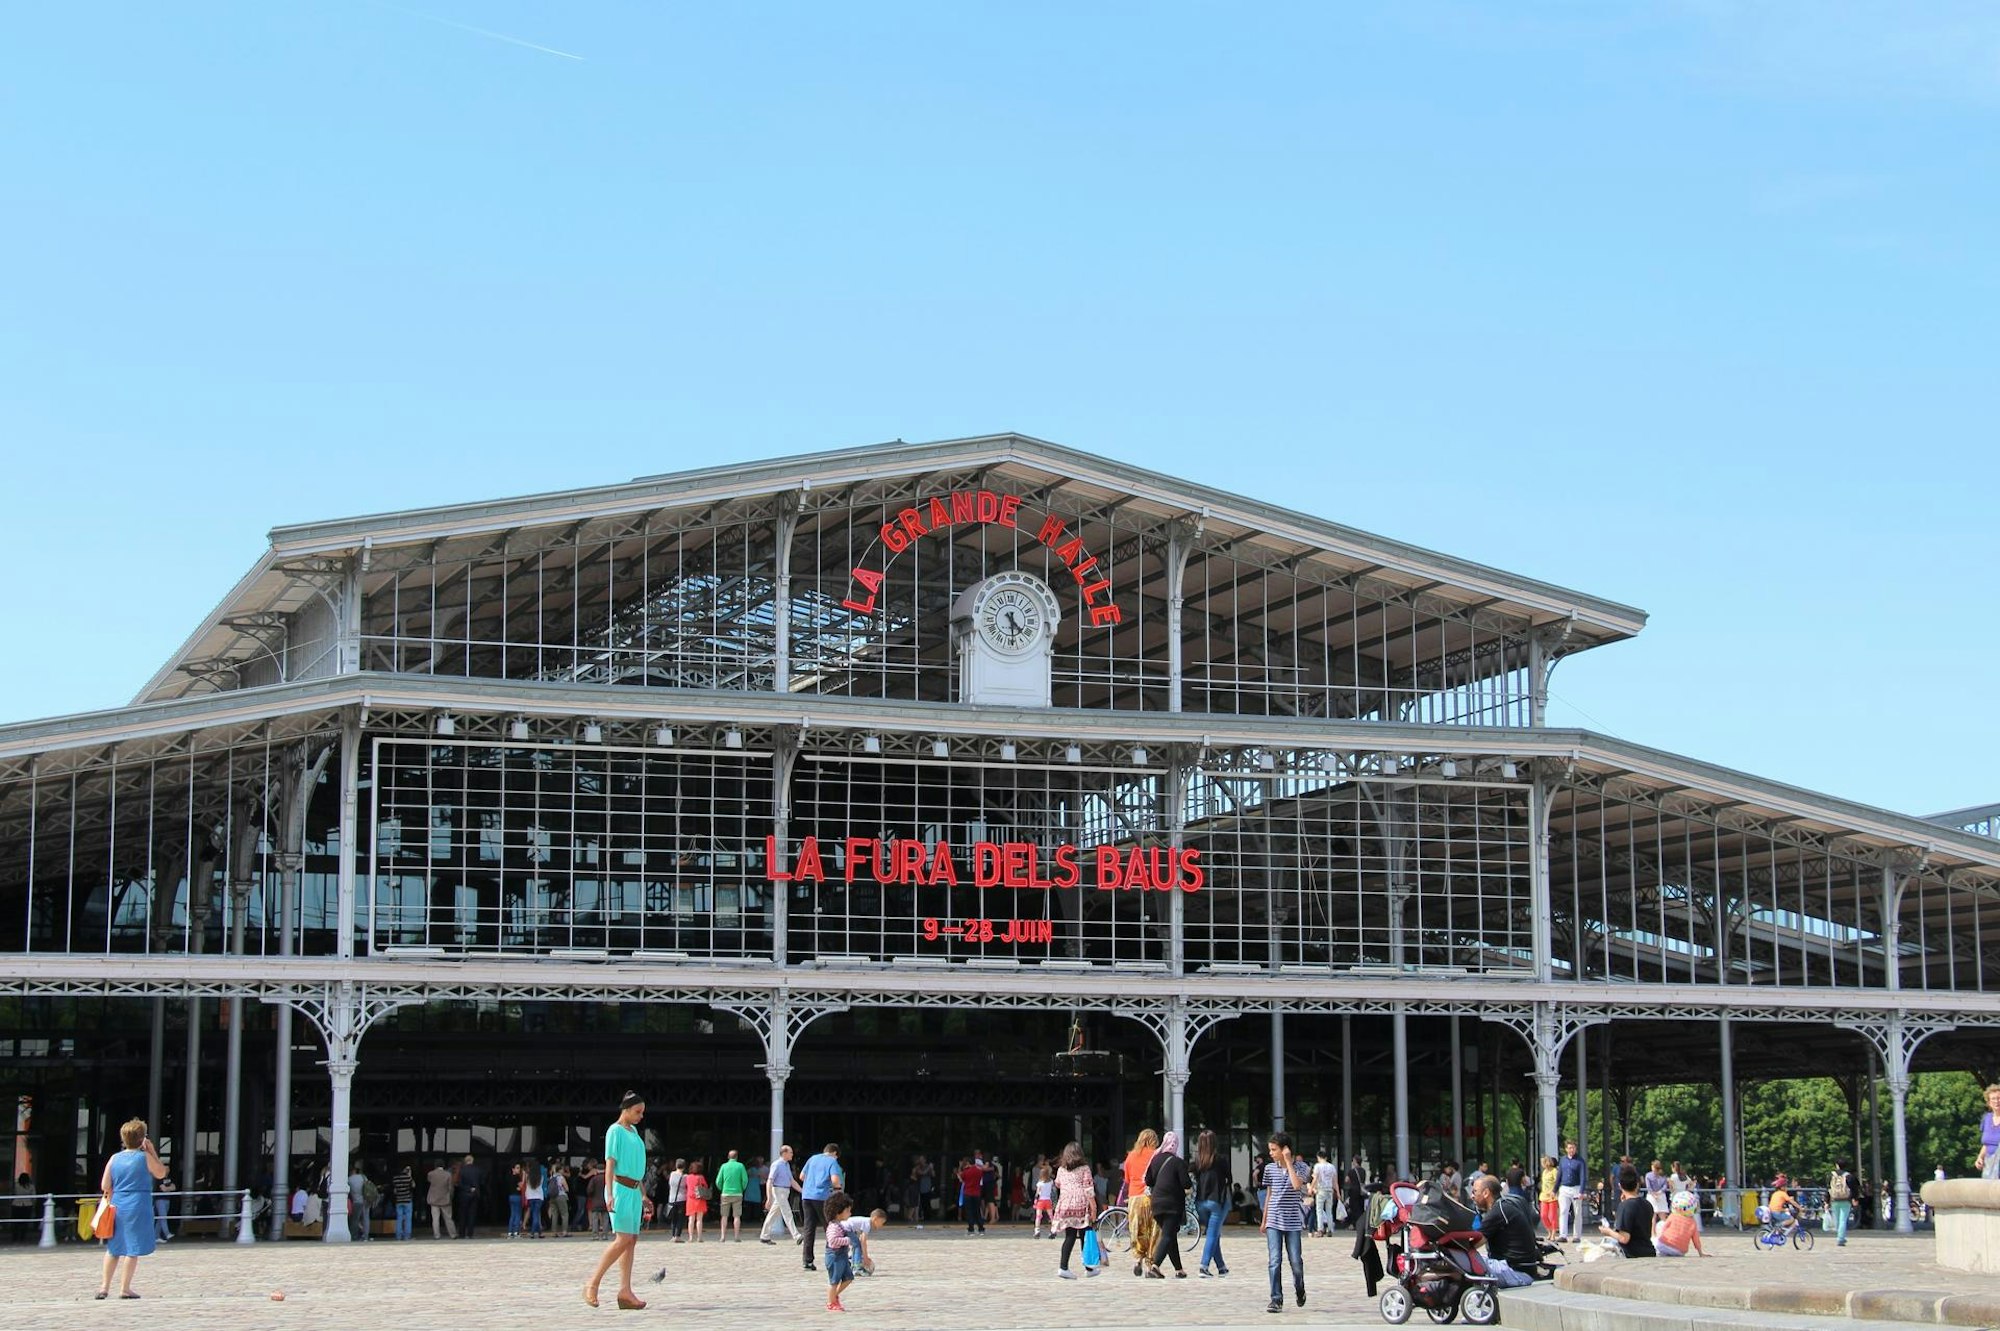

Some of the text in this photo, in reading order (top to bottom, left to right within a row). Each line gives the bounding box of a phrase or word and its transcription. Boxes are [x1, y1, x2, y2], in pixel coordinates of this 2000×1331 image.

[842, 490, 1122, 627] LA GRANDE HALLE
[766, 835, 1205, 893] LA FURA DELS BAUS
[1000, 919, 1053, 943] JUIN
